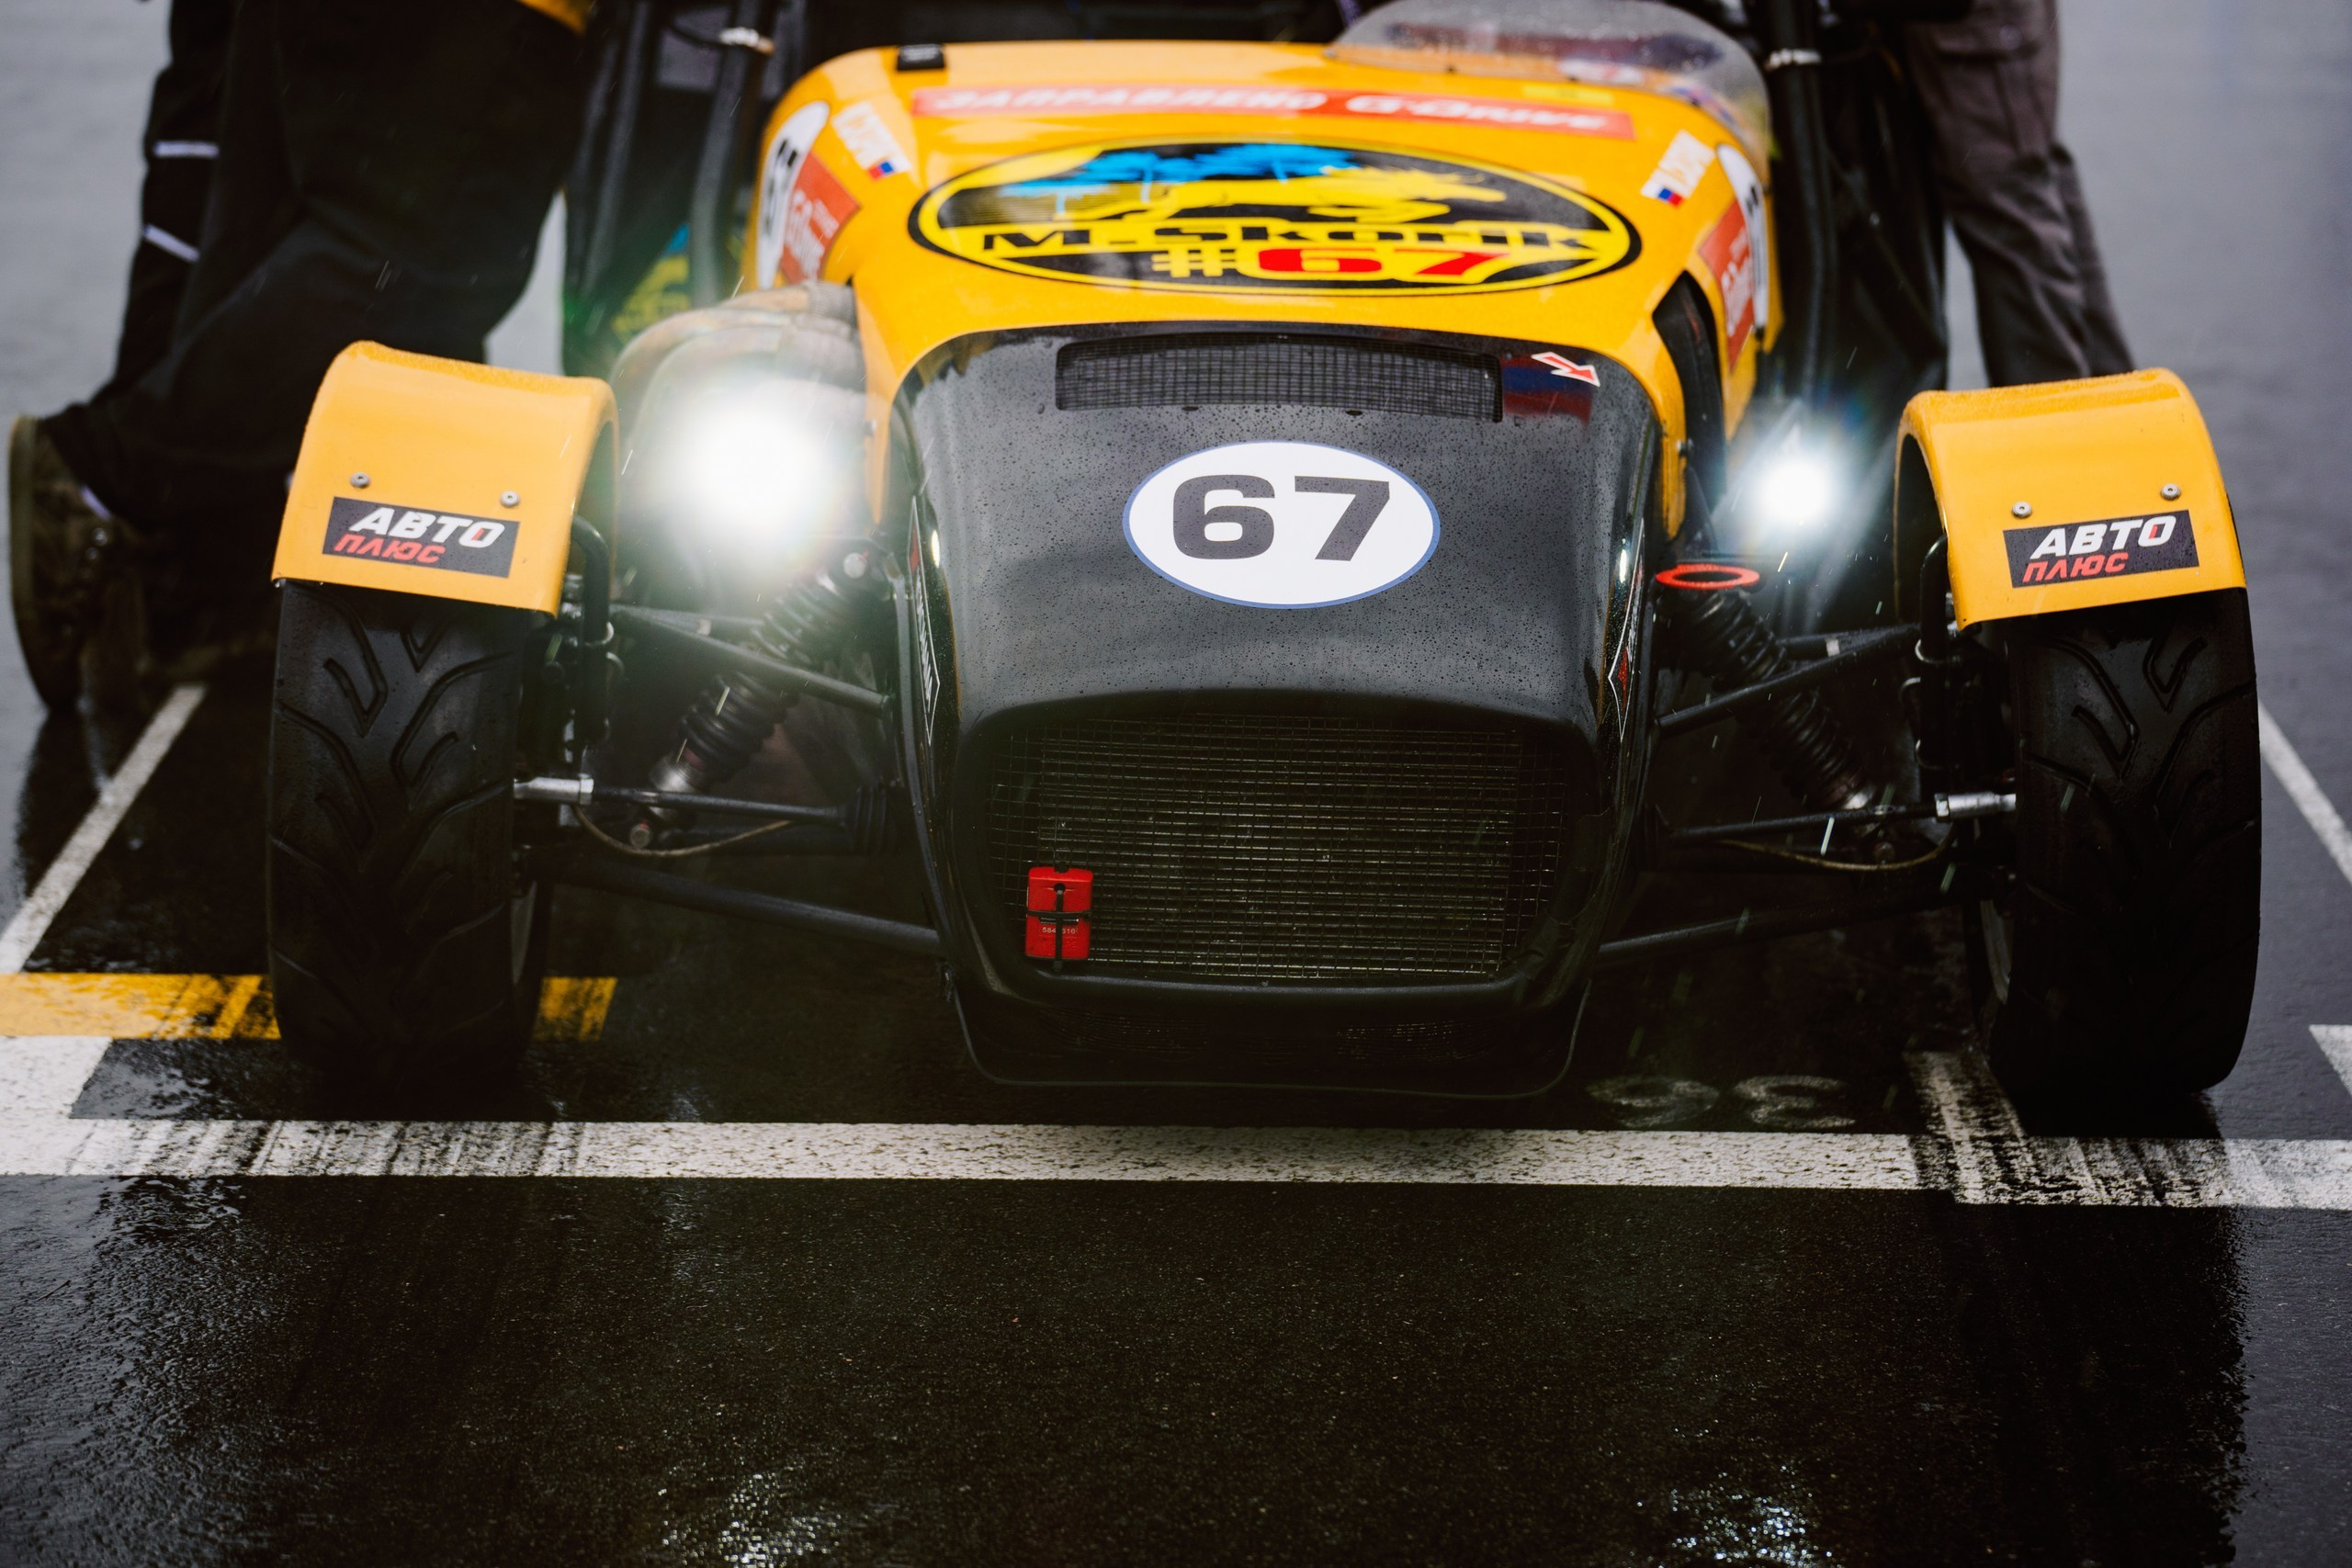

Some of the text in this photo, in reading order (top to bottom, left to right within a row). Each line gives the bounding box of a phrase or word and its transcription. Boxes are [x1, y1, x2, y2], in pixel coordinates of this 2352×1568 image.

[348, 507, 506, 548] АВТО
[1172, 473, 1391, 562] 67
[2030, 515, 2177, 559] АВТО
[334, 533, 447, 564] ПЛЮС
[2022, 552, 2129, 583] ПЛЮС
